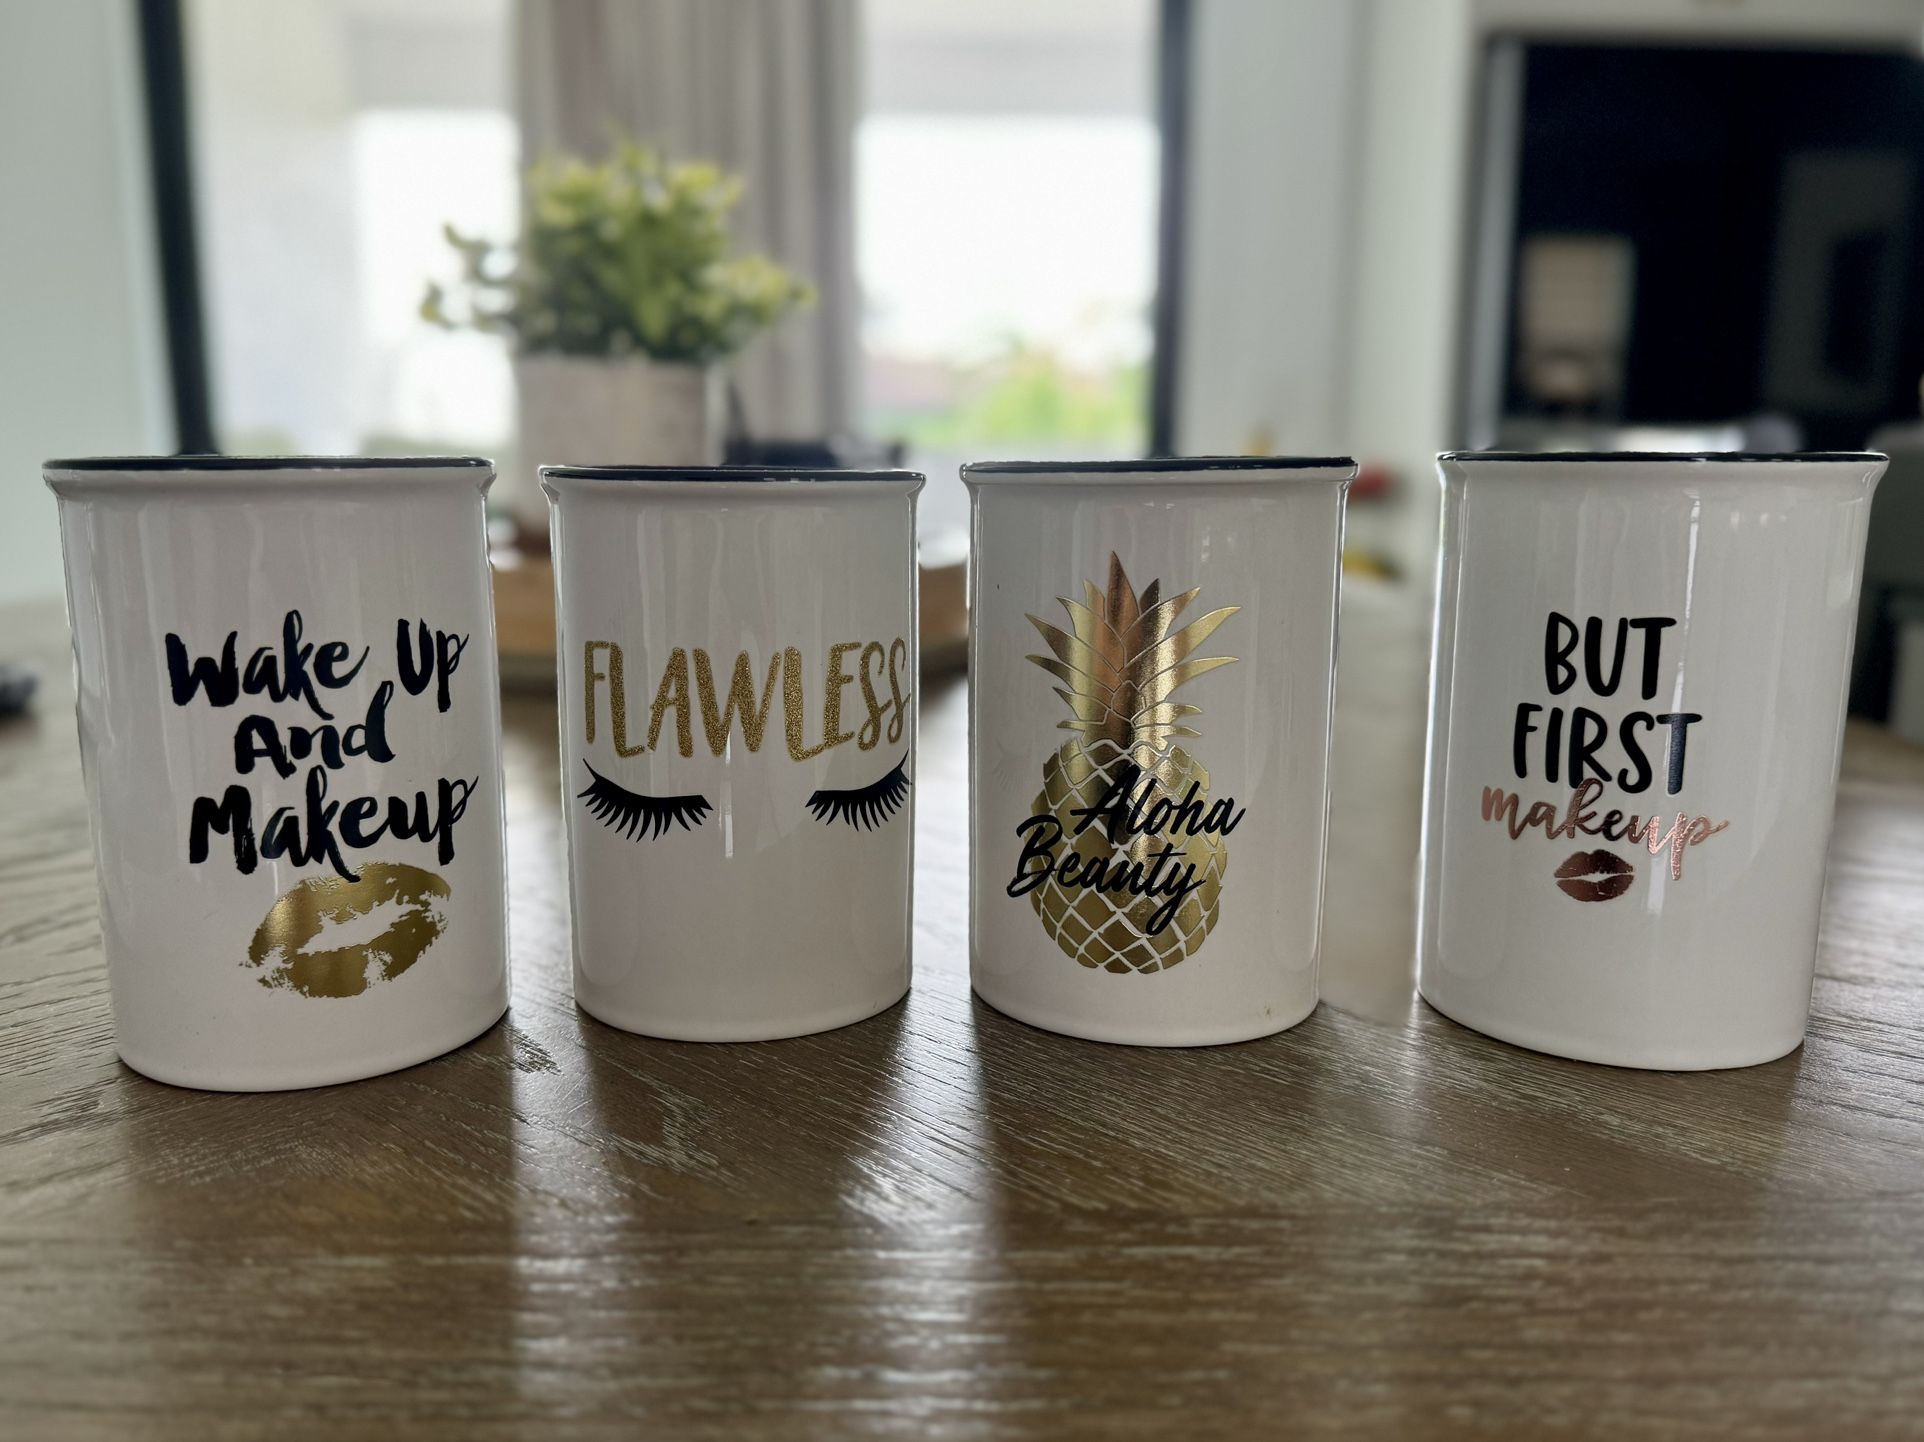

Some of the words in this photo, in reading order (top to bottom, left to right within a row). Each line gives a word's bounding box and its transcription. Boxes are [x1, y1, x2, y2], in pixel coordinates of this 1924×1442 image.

[165, 609, 370, 720] Wake
[396, 618, 470, 713] Up
[583, 637, 911, 762] FLAWLESS
[1545, 611, 1677, 700] BUT
[234, 681, 396, 779] And
[1513, 703, 1703, 795] FIRST
[189, 764, 479, 883] Makeup
[1070, 764, 1246, 844] Aloha
[1481, 777, 1730, 881] makeup
[1006, 814, 1207, 936] Beauty
